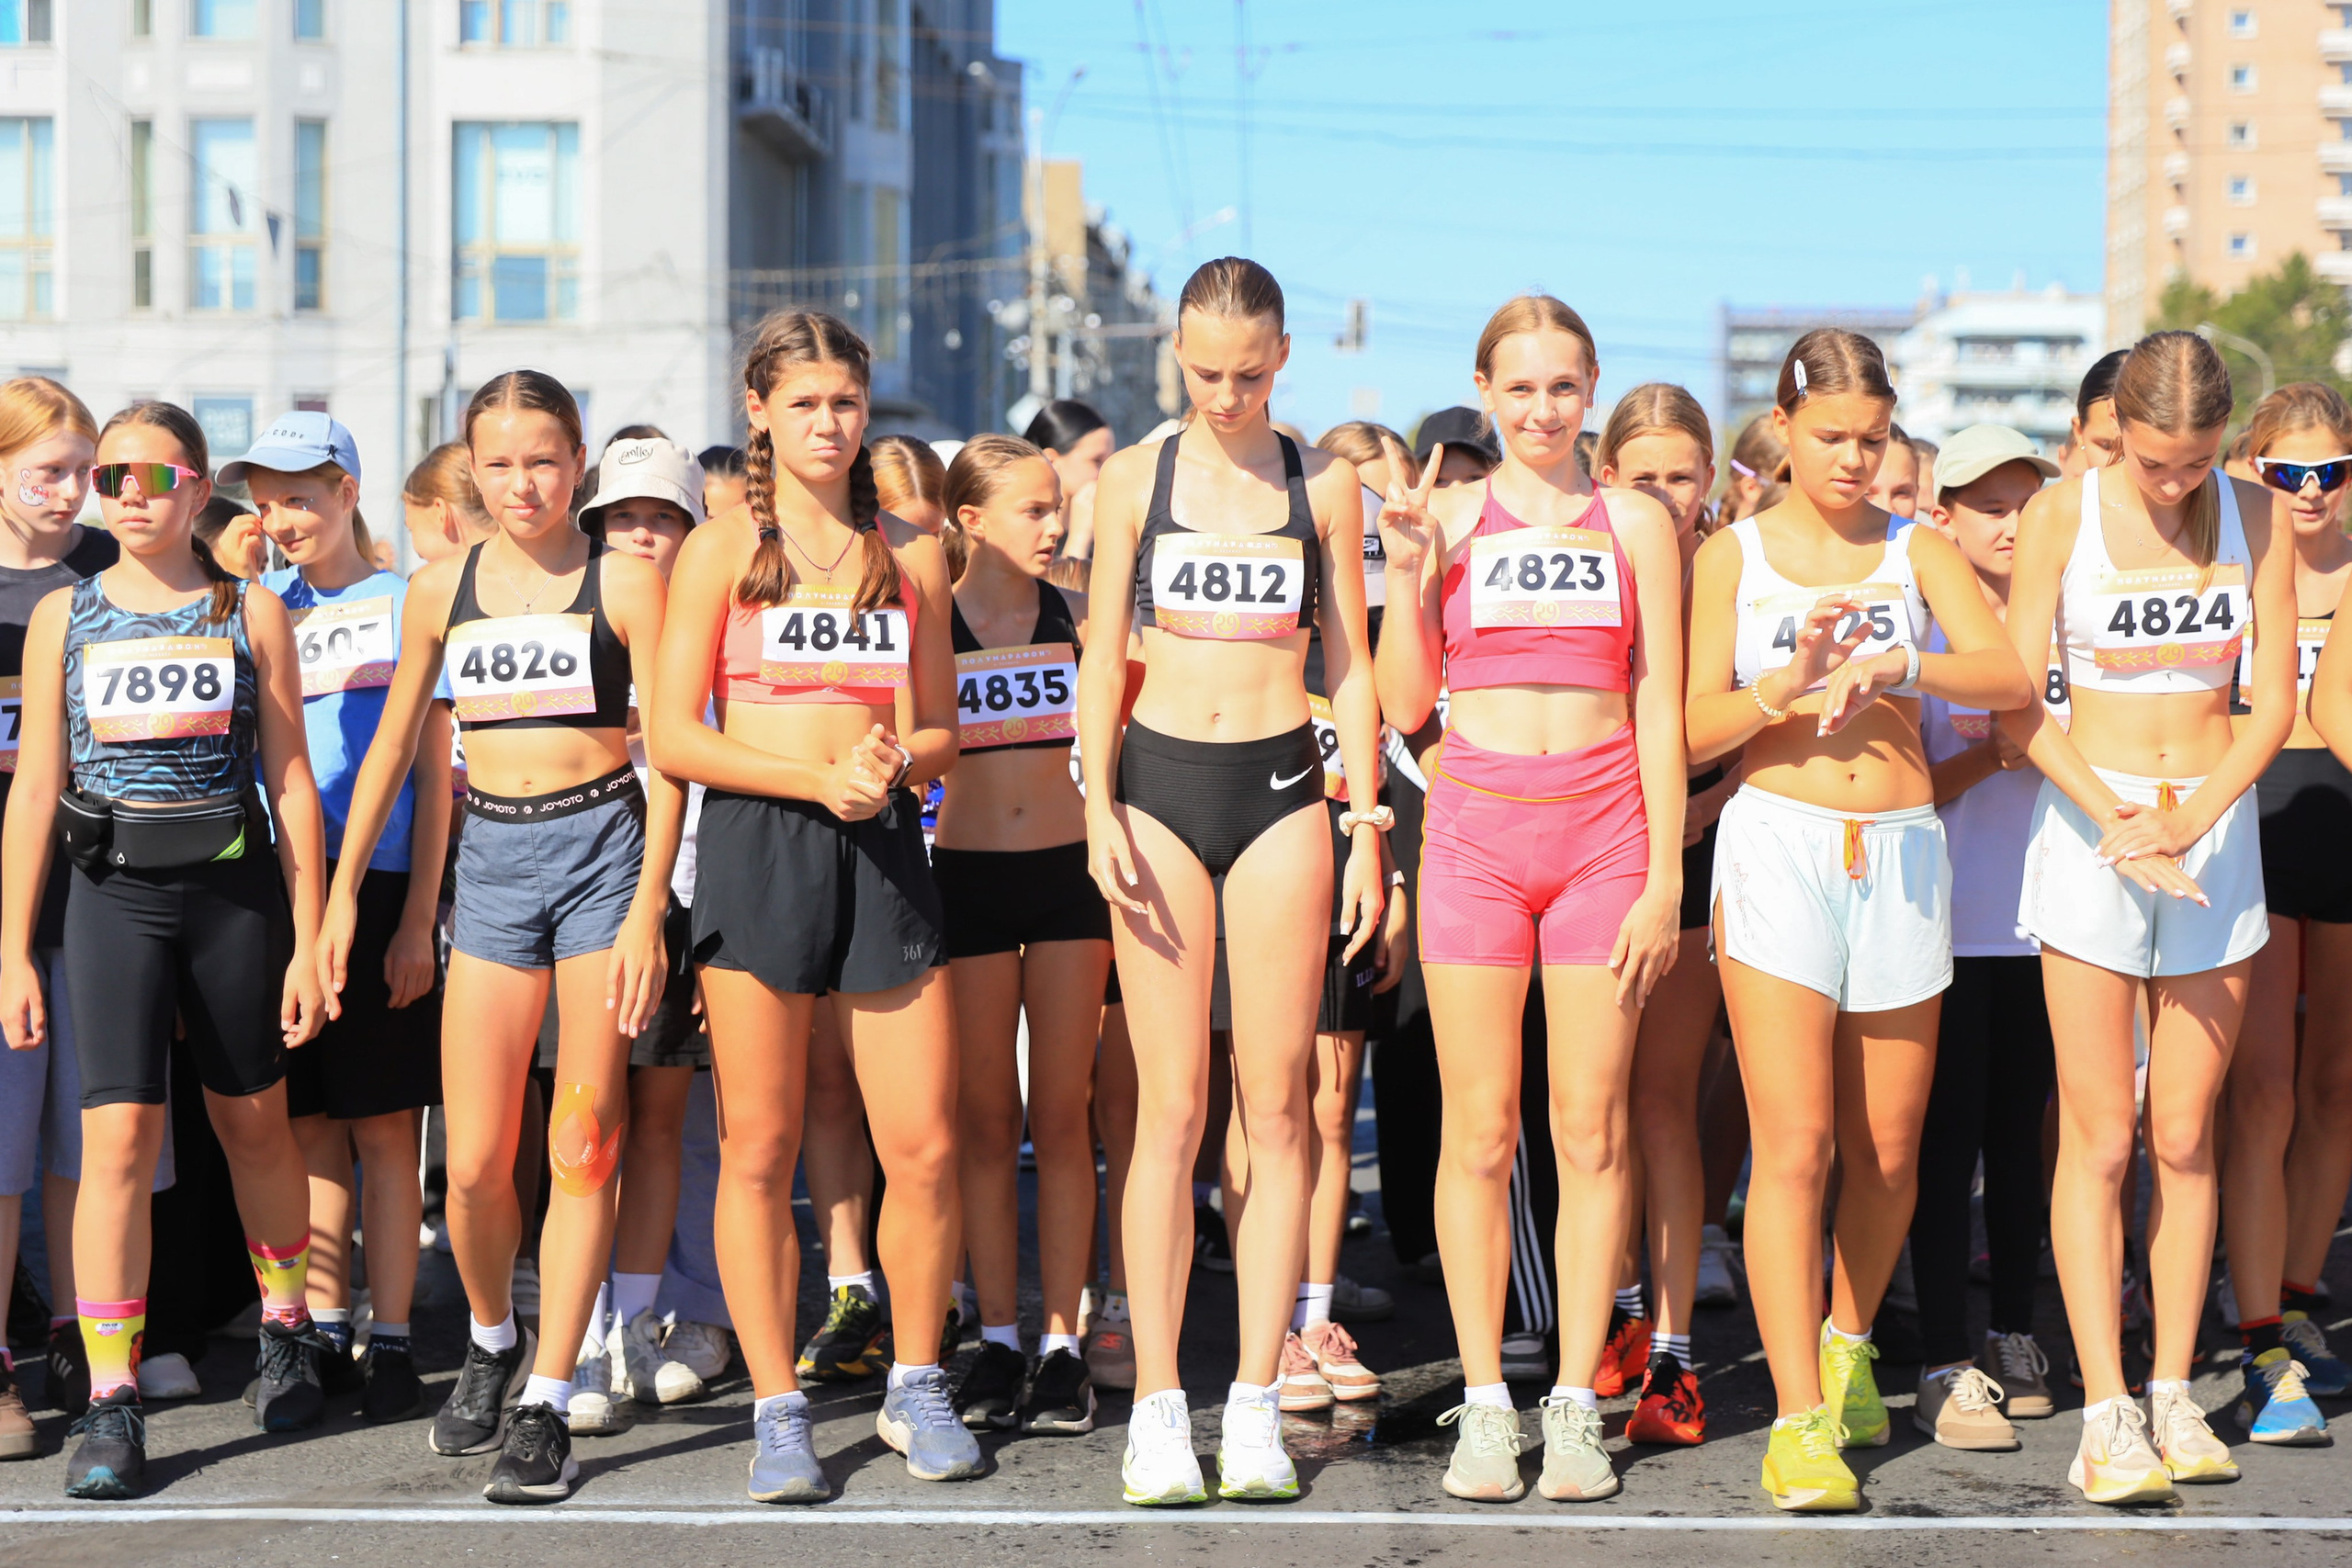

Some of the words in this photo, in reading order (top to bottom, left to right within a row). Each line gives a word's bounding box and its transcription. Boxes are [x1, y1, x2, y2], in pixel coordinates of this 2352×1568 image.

[1169, 562, 1286, 604] 4812
[1485, 553, 1605, 591] 4823
[778, 613, 895, 651] 4841
[1772, 604, 1894, 653] 425
[2108, 592, 2234, 637] 4824
[296, 622, 379, 663] 607
[460, 640, 578, 684] 4826
[96, 662, 221, 706] 7898
[957, 669, 1069, 714] 4835
[482, 801, 516, 815] JOMOTO
[540, 794, 584, 812] JOMOTO
